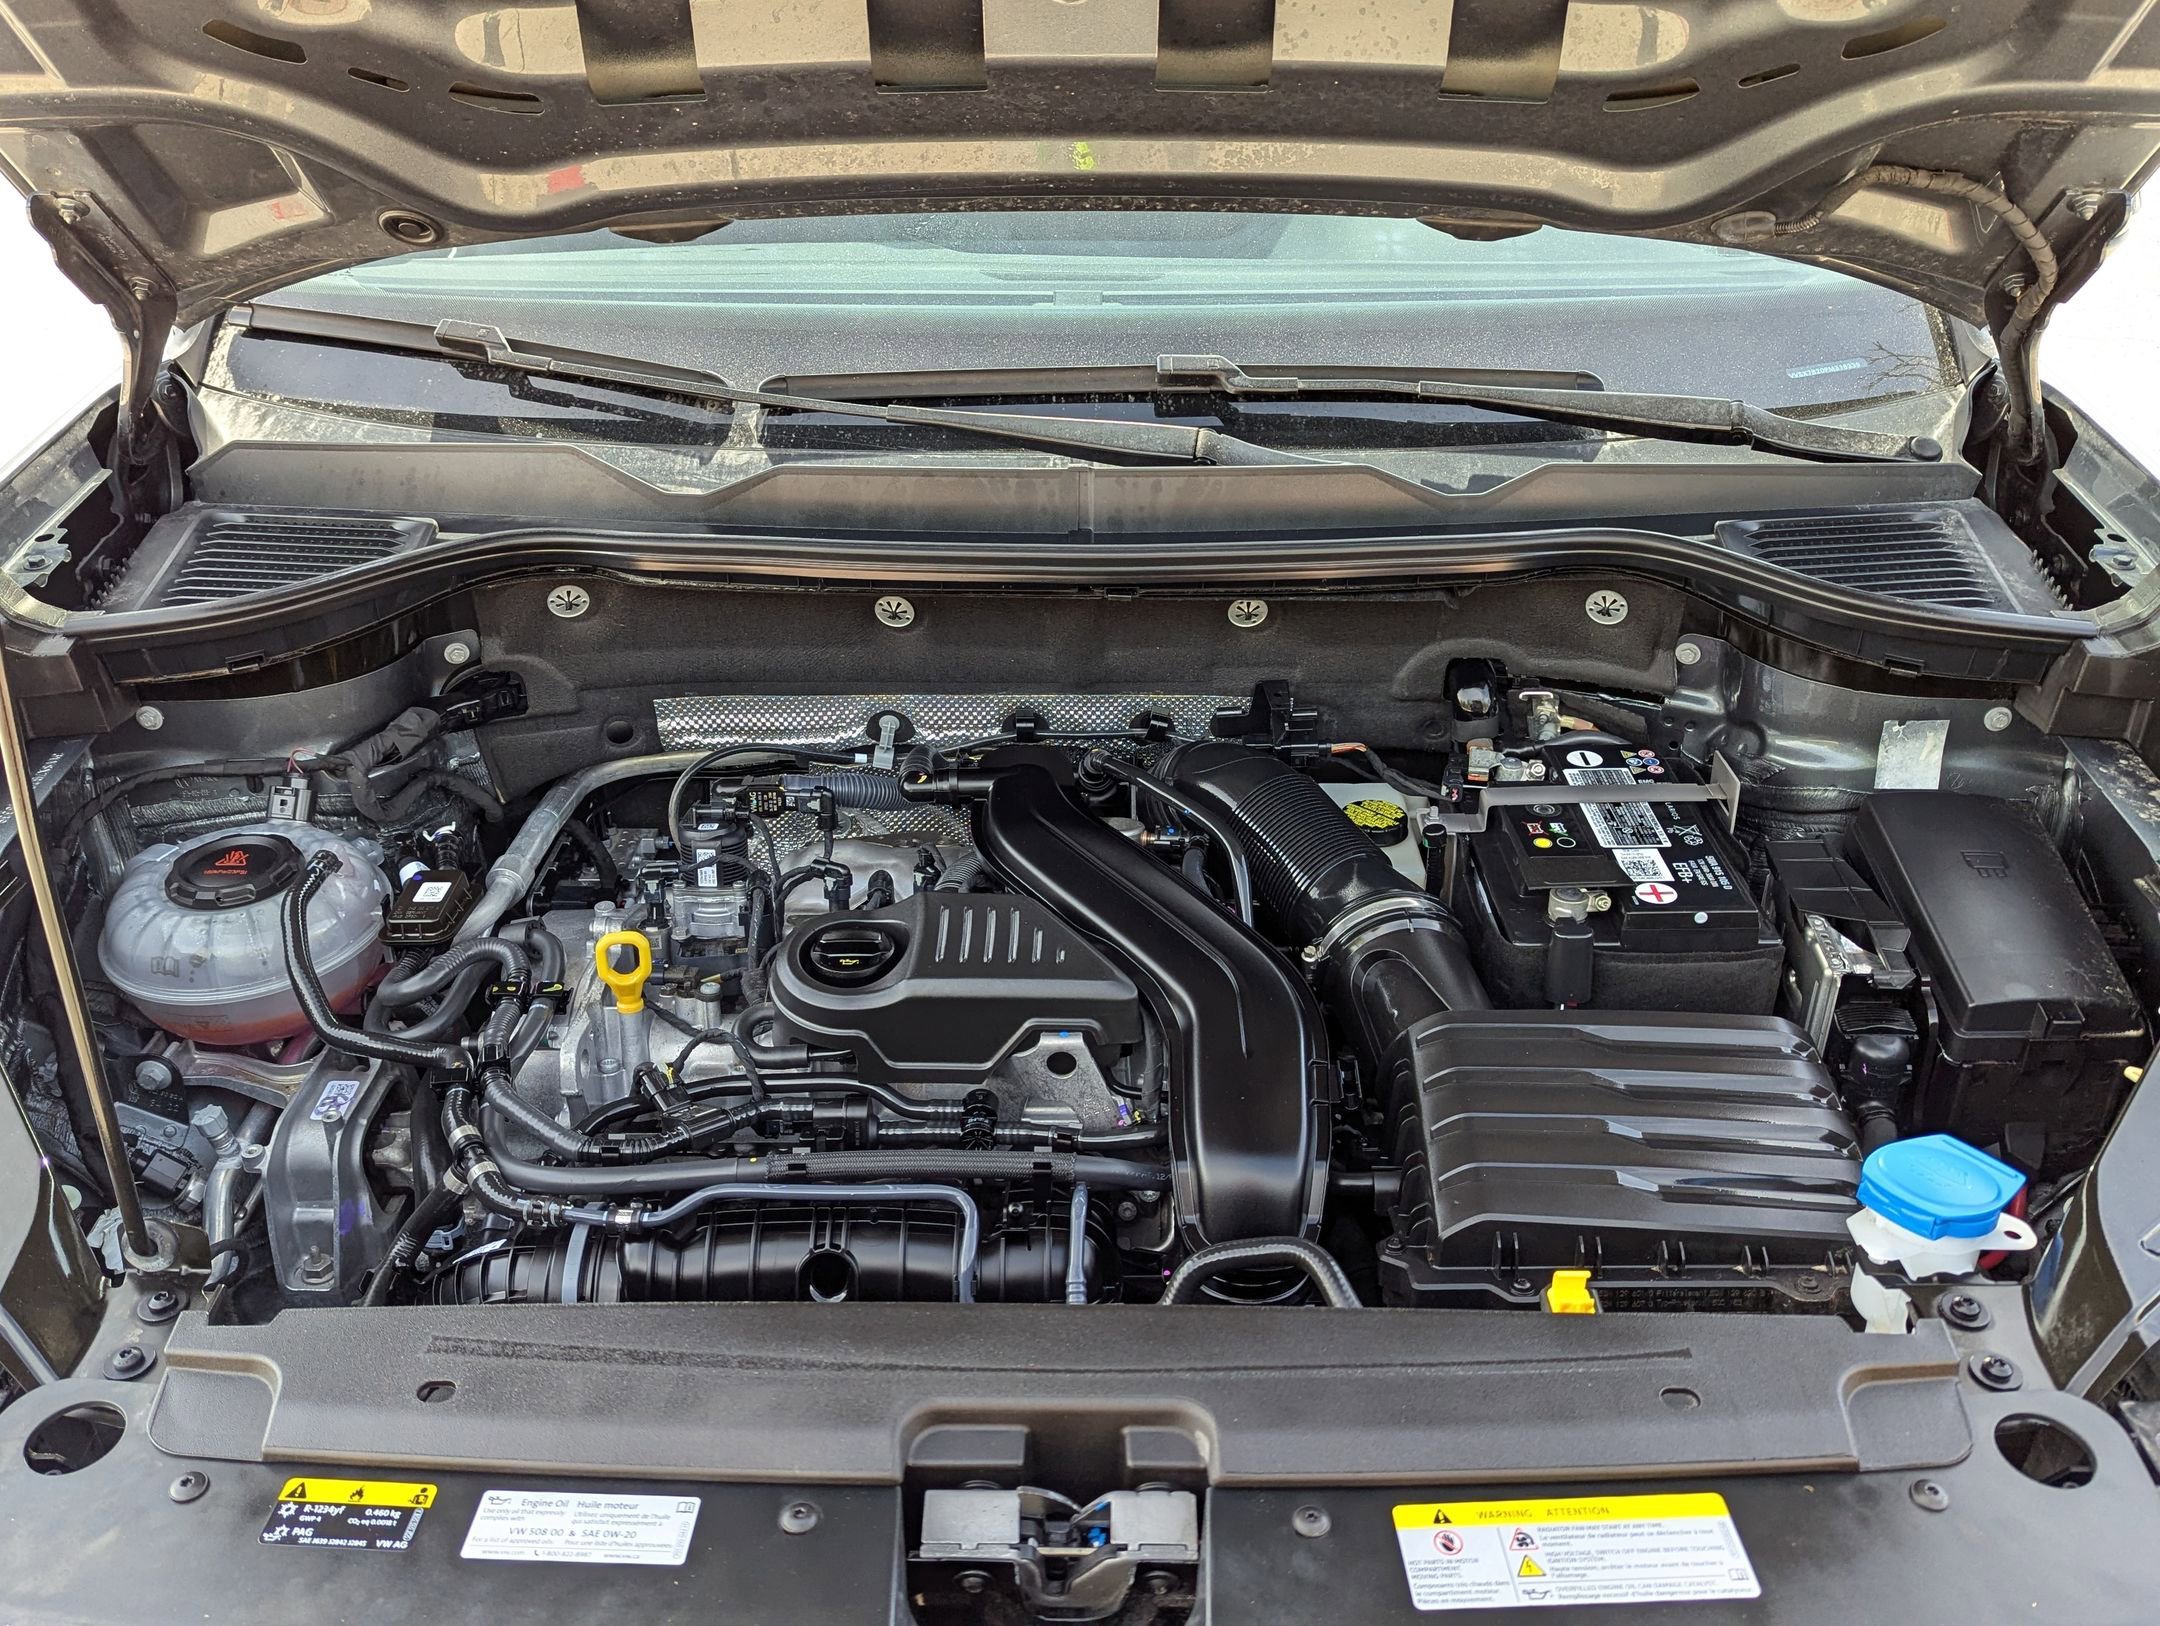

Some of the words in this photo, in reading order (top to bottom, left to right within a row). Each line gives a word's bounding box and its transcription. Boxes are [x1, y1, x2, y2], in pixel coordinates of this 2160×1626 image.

[1672, 862, 1694, 884] EFB+
[521, 1498, 554, 1508] Engine
[555, 1499, 570, 1508] Oil
[576, 1500, 602, 1509] Huile
[603, 1501, 640, 1510] moteur
[303, 1503, 346, 1517] R-1234yf
[365, 1508, 390, 1518] 0.460
[390, 1509, 402, 1519] kg
[1476, 1508, 1533, 1520] WARNING
[1546, 1506, 1611, 1517] ATTENTION
[292, 1527, 314, 1537] PAG
[509, 1527, 527, 1535] VW
[529, 1527, 548, 1536] 508
[550, 1528, 564, 1536] 00
[568, 1529, 576, 1537] &
[581, 1529, 601, 1537] SAE
[602, 1530, 637, 1539] 0W-20
[298, 1536, 312, 1544] SAE
[376, 1540, 393, 1548] VW
[393, 1540, 408, 1549] AG
